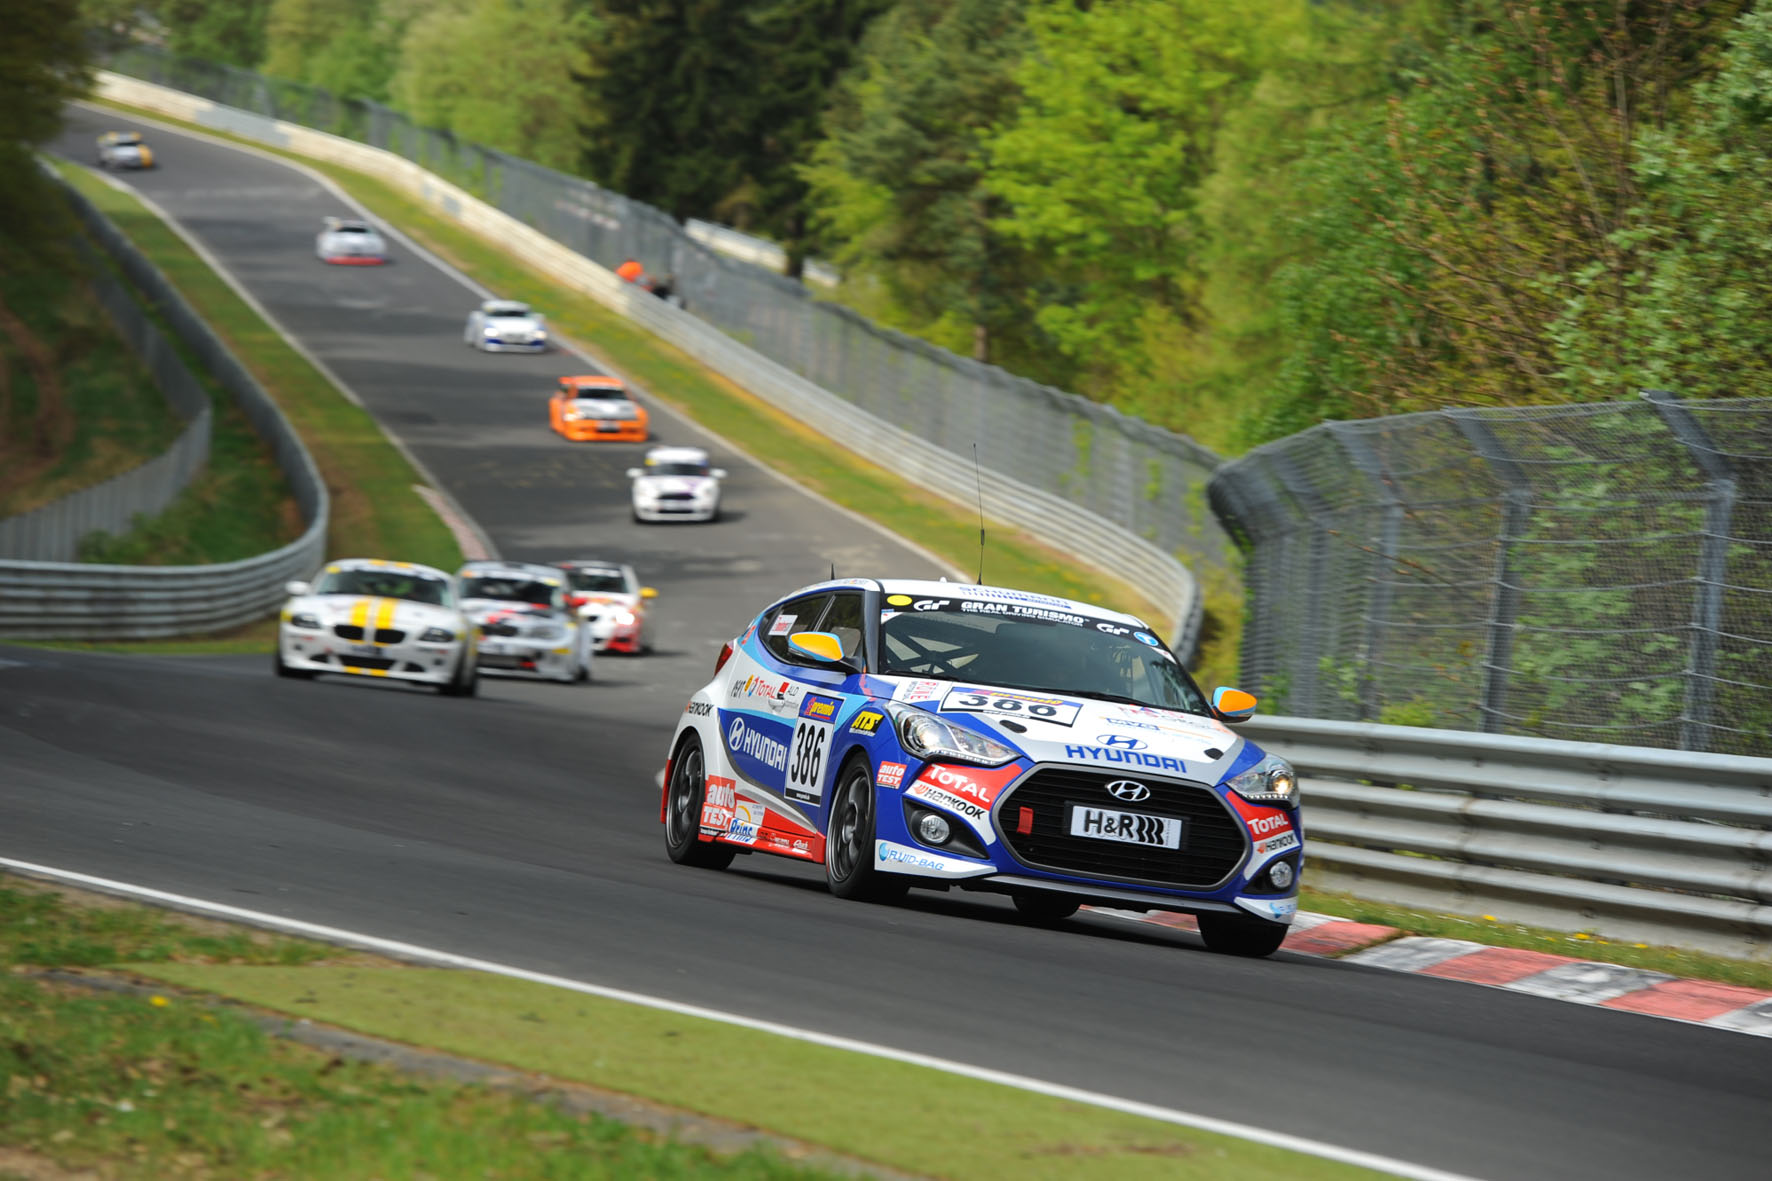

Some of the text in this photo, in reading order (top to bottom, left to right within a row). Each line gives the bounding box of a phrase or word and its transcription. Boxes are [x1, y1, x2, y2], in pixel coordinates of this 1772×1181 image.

[961, 601, 1011, 612] GRAN
[1012, 606, 1085, 624] TURISMO
[755, 680, 776, 699] TOTAL
[851, 710, 884, 731] ATS
[743, 727, 788, 772] HYUNDAI
[791, 722, 825, 787] 386
[1065, 745, 1187, 773] HYUNDAI
[878, 774, 900, 785] TEST
[879, 764, 905, 776] auto
[930, 763, 990, 803] TOTAL
[707, 783, 736, 809] auto
[703, 805, 734, 827] TEST
[1083, 809, 1135, 840] H&R
[1247, 813, 1288, 835] TOTAL
[888, 849, 945, 871] FLUID-BAG
